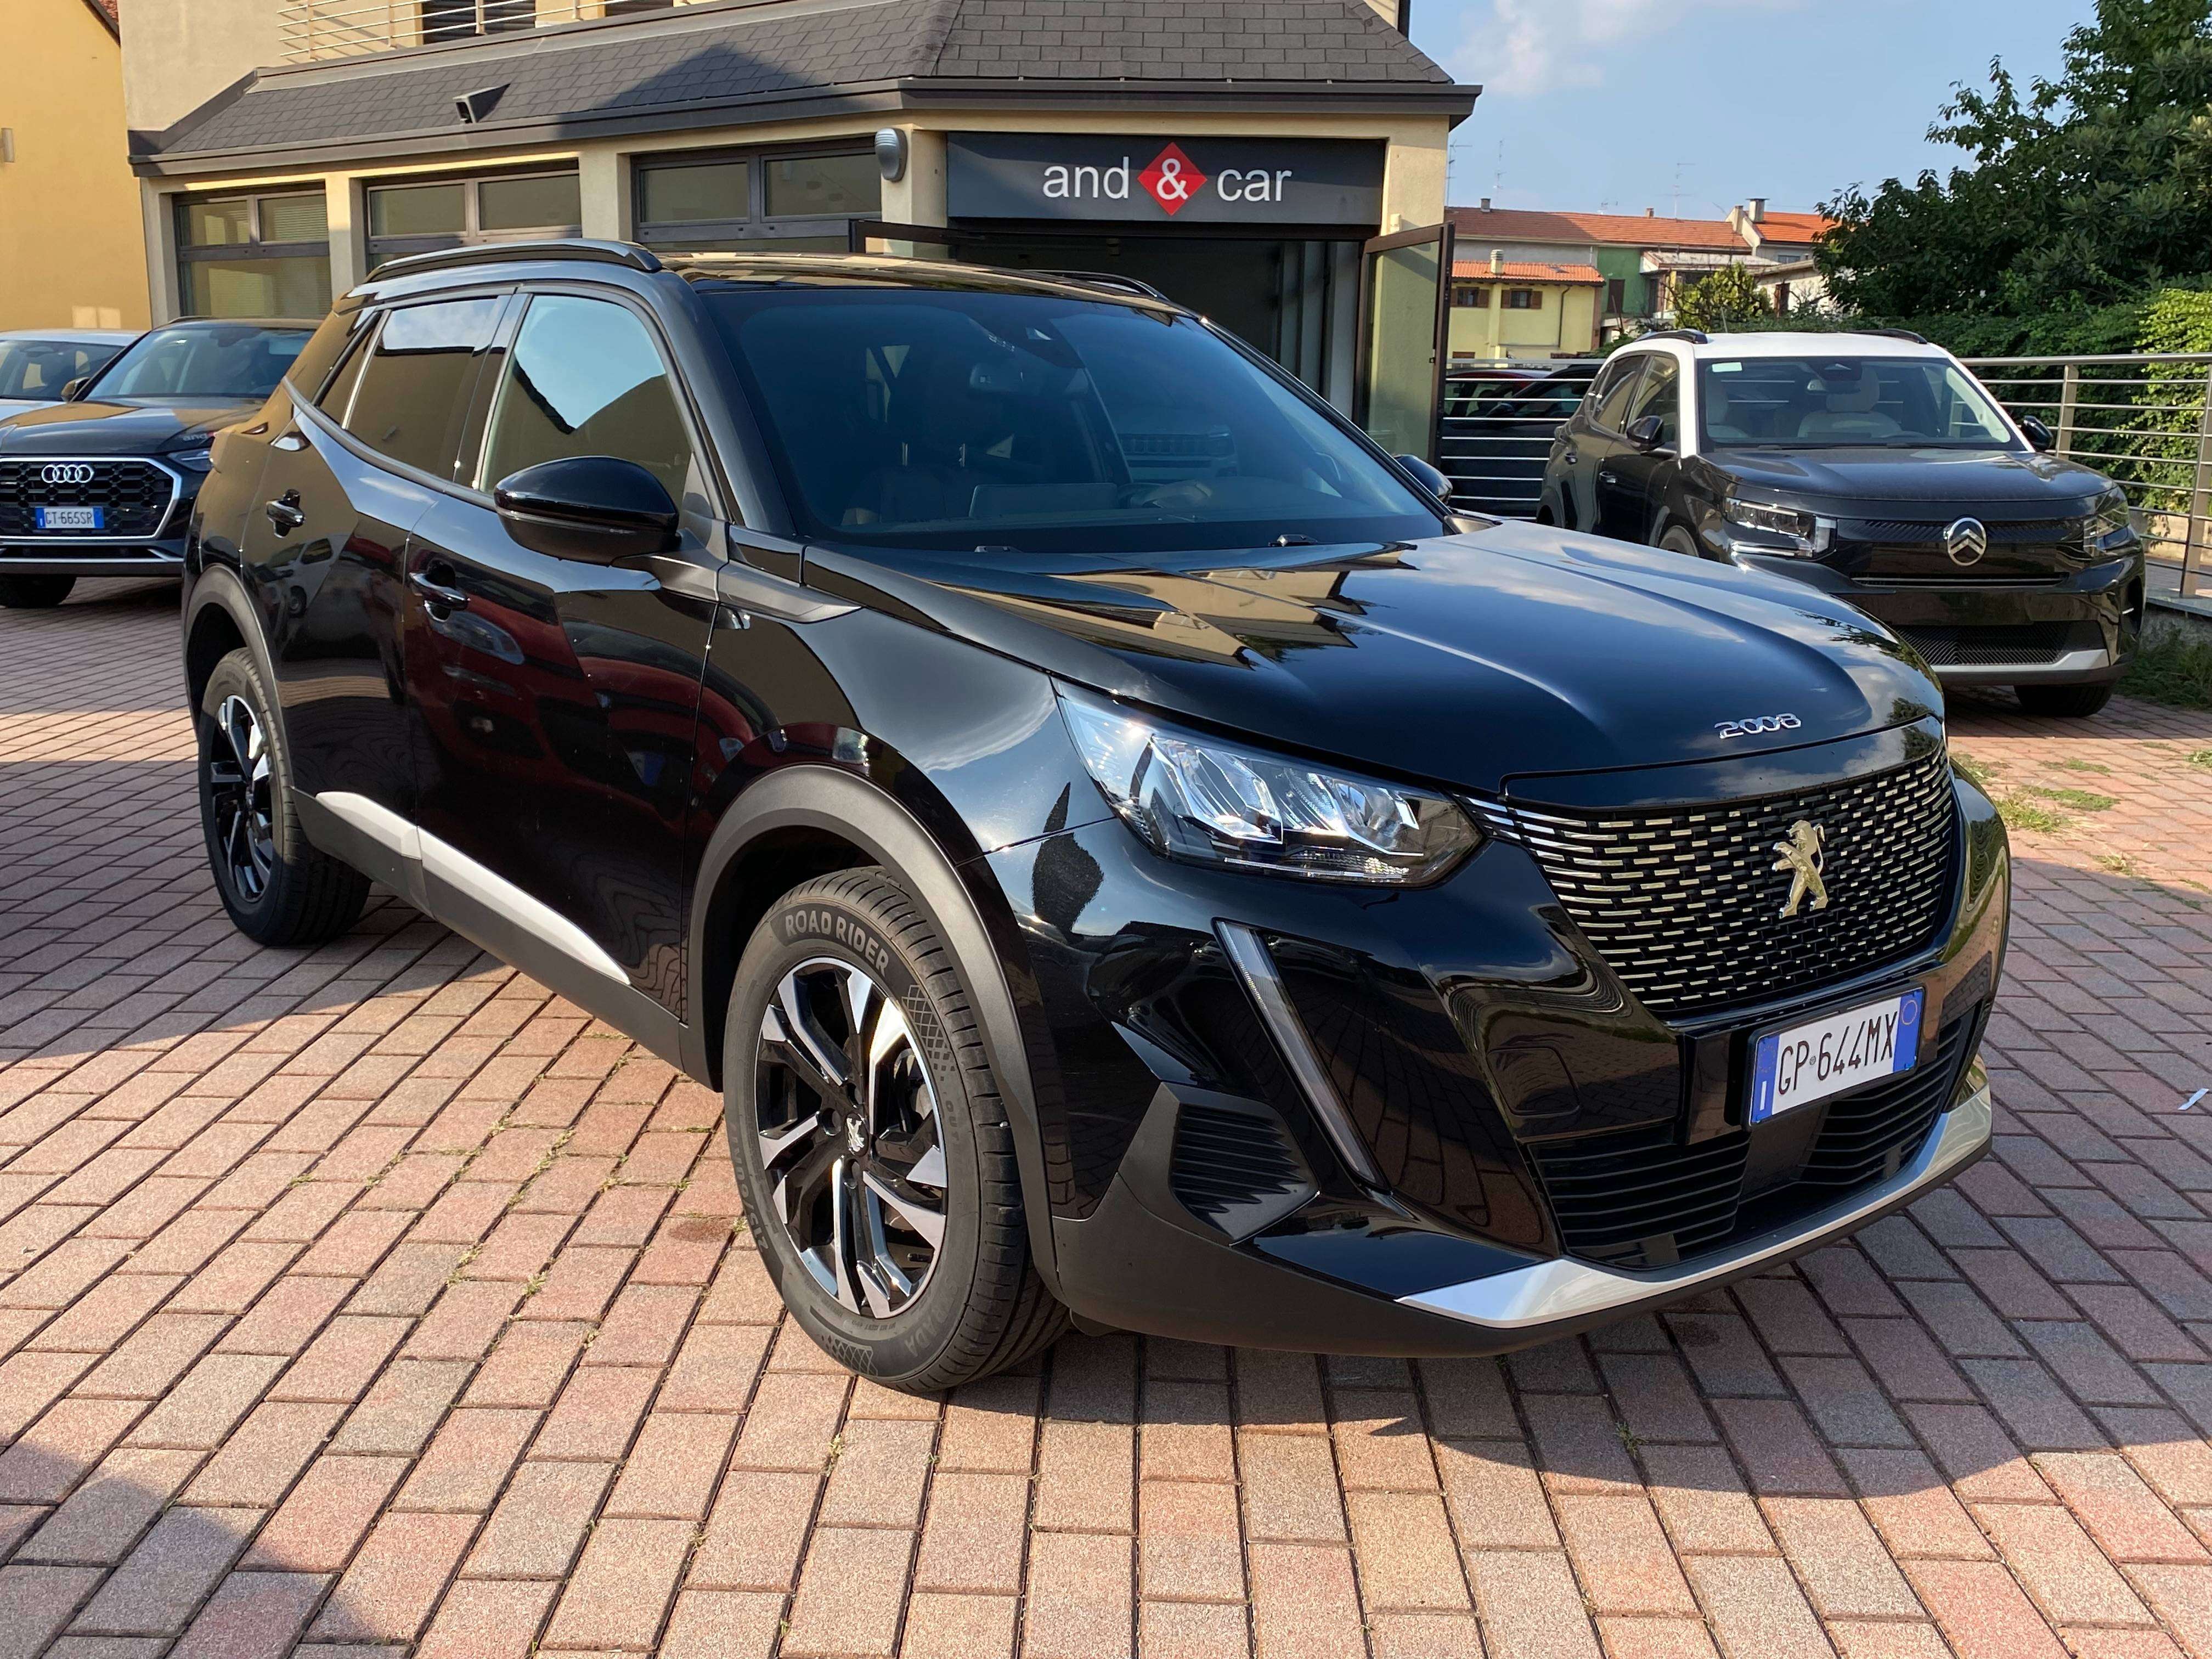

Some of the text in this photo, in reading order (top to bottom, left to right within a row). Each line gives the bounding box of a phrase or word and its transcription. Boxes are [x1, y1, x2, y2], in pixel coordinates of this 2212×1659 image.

[1043, 156, 1293, 202] and & car
[1714, 713, 1802, 739] 2008
[785, 910, 889, 978] ROAD RIDER
